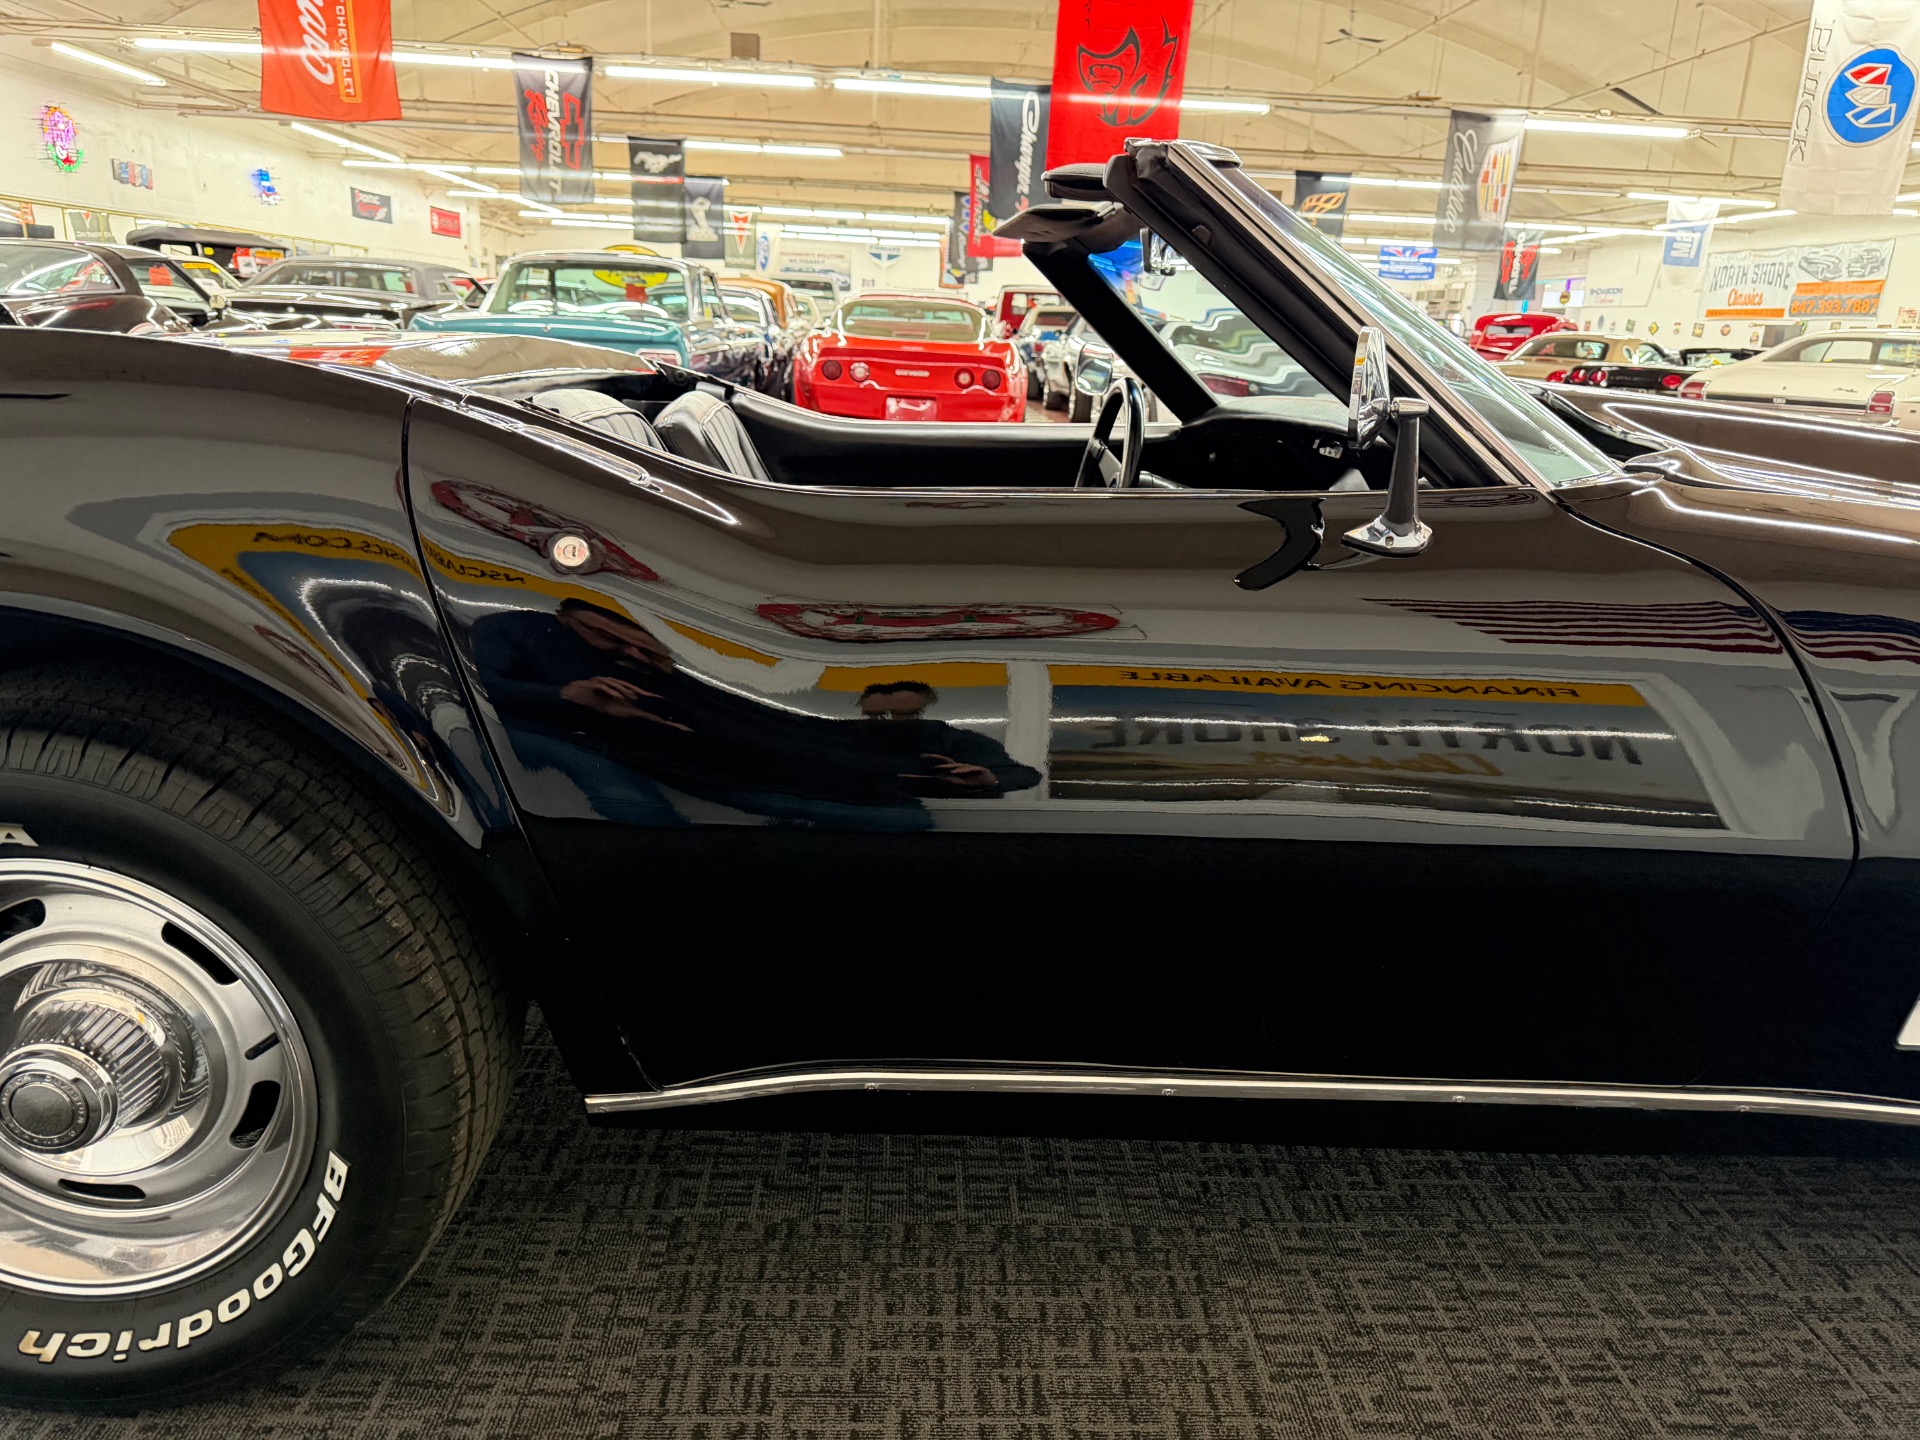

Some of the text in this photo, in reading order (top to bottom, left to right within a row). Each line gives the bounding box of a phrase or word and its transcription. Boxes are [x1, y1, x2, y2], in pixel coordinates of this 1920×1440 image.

[335, 5, 355, 96] CHEVROLET
[1790, 18, 1836, 162] BUICK
[544, 68, 562, 195] CHEVROLET
[1014, 91, 1041, 195] Charger
[1444, 129, 1478, 234] Cadillac
[1709, 263, 1750, 293] NORTH
[1751, 260, 1794, 291] SHORE
[1727, 287, 1764, 307] Classics
[1790, 298, 1880, 315] 847.393.7887
[18, 1150, 351, 1364] BFGoodrich
